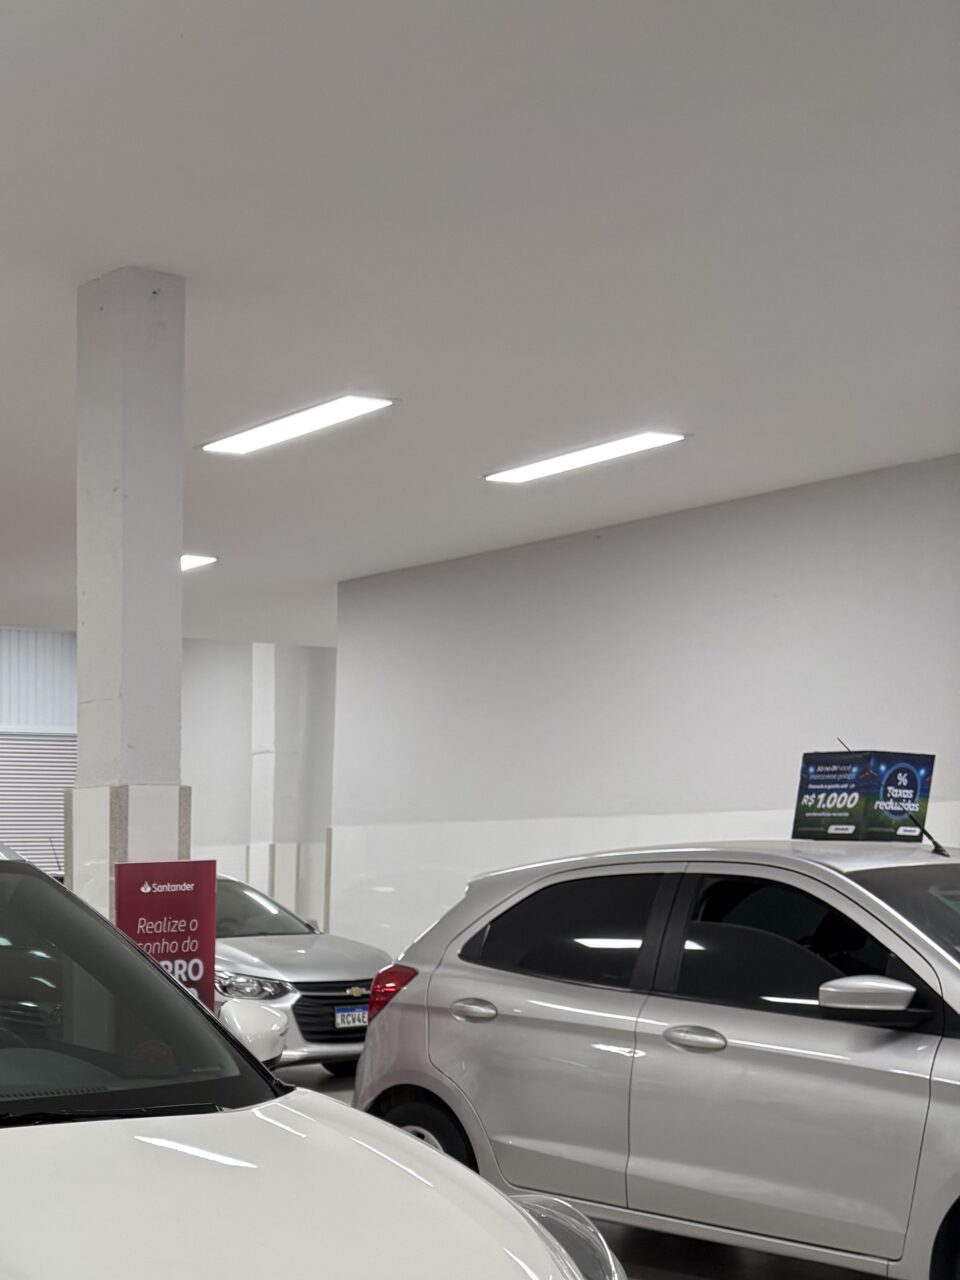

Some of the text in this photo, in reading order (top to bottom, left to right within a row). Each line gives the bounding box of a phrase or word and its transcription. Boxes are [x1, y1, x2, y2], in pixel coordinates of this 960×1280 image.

[887, 786, 914, 799] Taxas
[801, 792, 859, 809] R$ 1.000
[874, 799, 920, 812] reduzidas
[152, 882, 194, 893] Santander
[137, 917, 198, 934] Realize o
[182, 937, 199, 953] do
[341, 1011, 367, 1025] RCV4E
